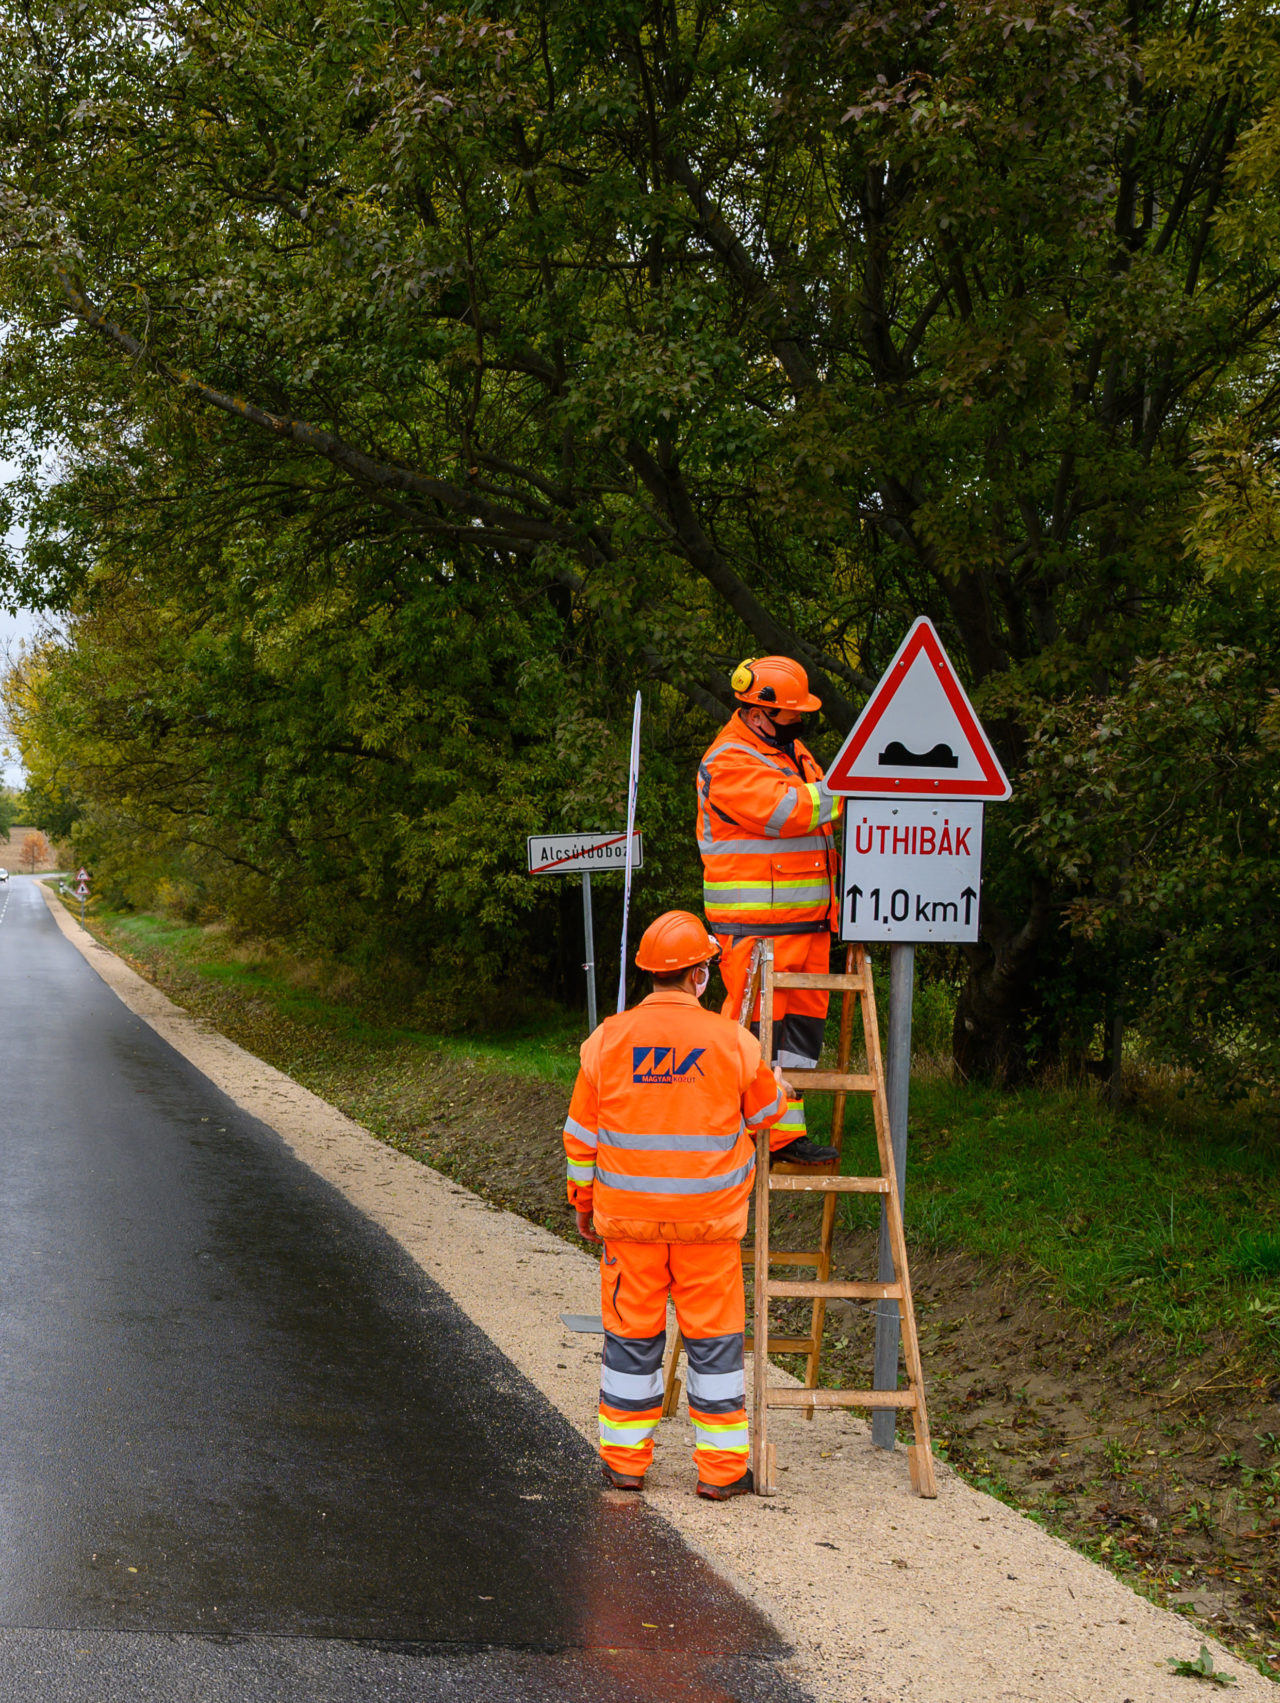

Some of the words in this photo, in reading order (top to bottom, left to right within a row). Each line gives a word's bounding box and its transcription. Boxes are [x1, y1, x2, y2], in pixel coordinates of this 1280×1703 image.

[855, 817, 972, 856] ÚTHIBÁK
[915, 894, 958, 922] km
[642, 1074, 672, 1083] MAGYAR
